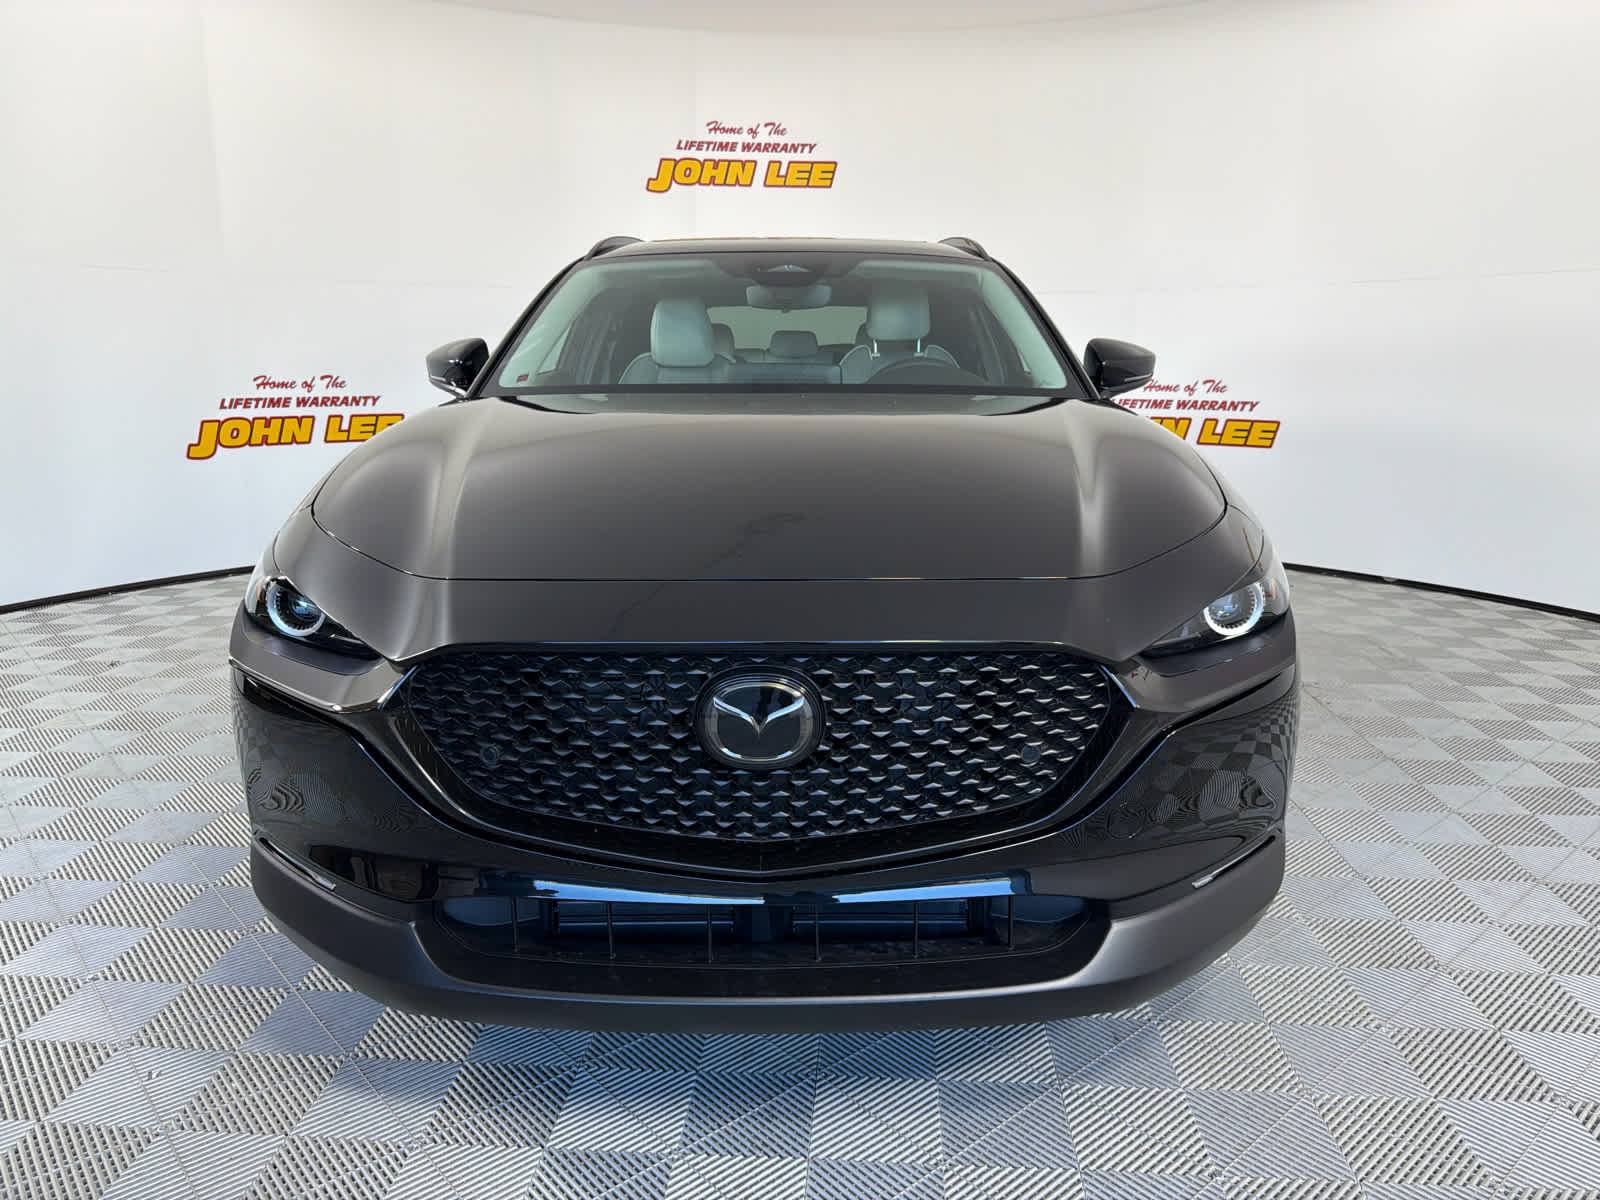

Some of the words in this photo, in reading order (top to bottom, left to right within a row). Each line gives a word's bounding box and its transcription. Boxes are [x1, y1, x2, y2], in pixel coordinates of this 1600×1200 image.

[706, 121, 743, 136] Home
[747, 124, 759, 138] of
[764, 122, 787, 136] The
[676, 140, 737, 152] LIFETIME
[741, 142, 816, 153] WARRANTY
[646, 158, 756, 193] JOHN
[763, 160, 837, 188] LEE
[253, 375, 296, 390] Home
[301, 377, 313, 392] of
[319, 375, 346, 389] The
[1143, 380, 1180, 392] Home
[1184, 381, 1198, 396] of
[1203, 379, 1227, 393] The
[219, 397, 291, 409] LIFETIME
[295, 395, 381, 408] WARRANTY
[1112, 399, 1173, 409] IFETIME
[1175, 400, 1260, 412] WARRANTY
[187, 416, 315, 460] JOHN
[1196, 418, 1280, 448] LEE
